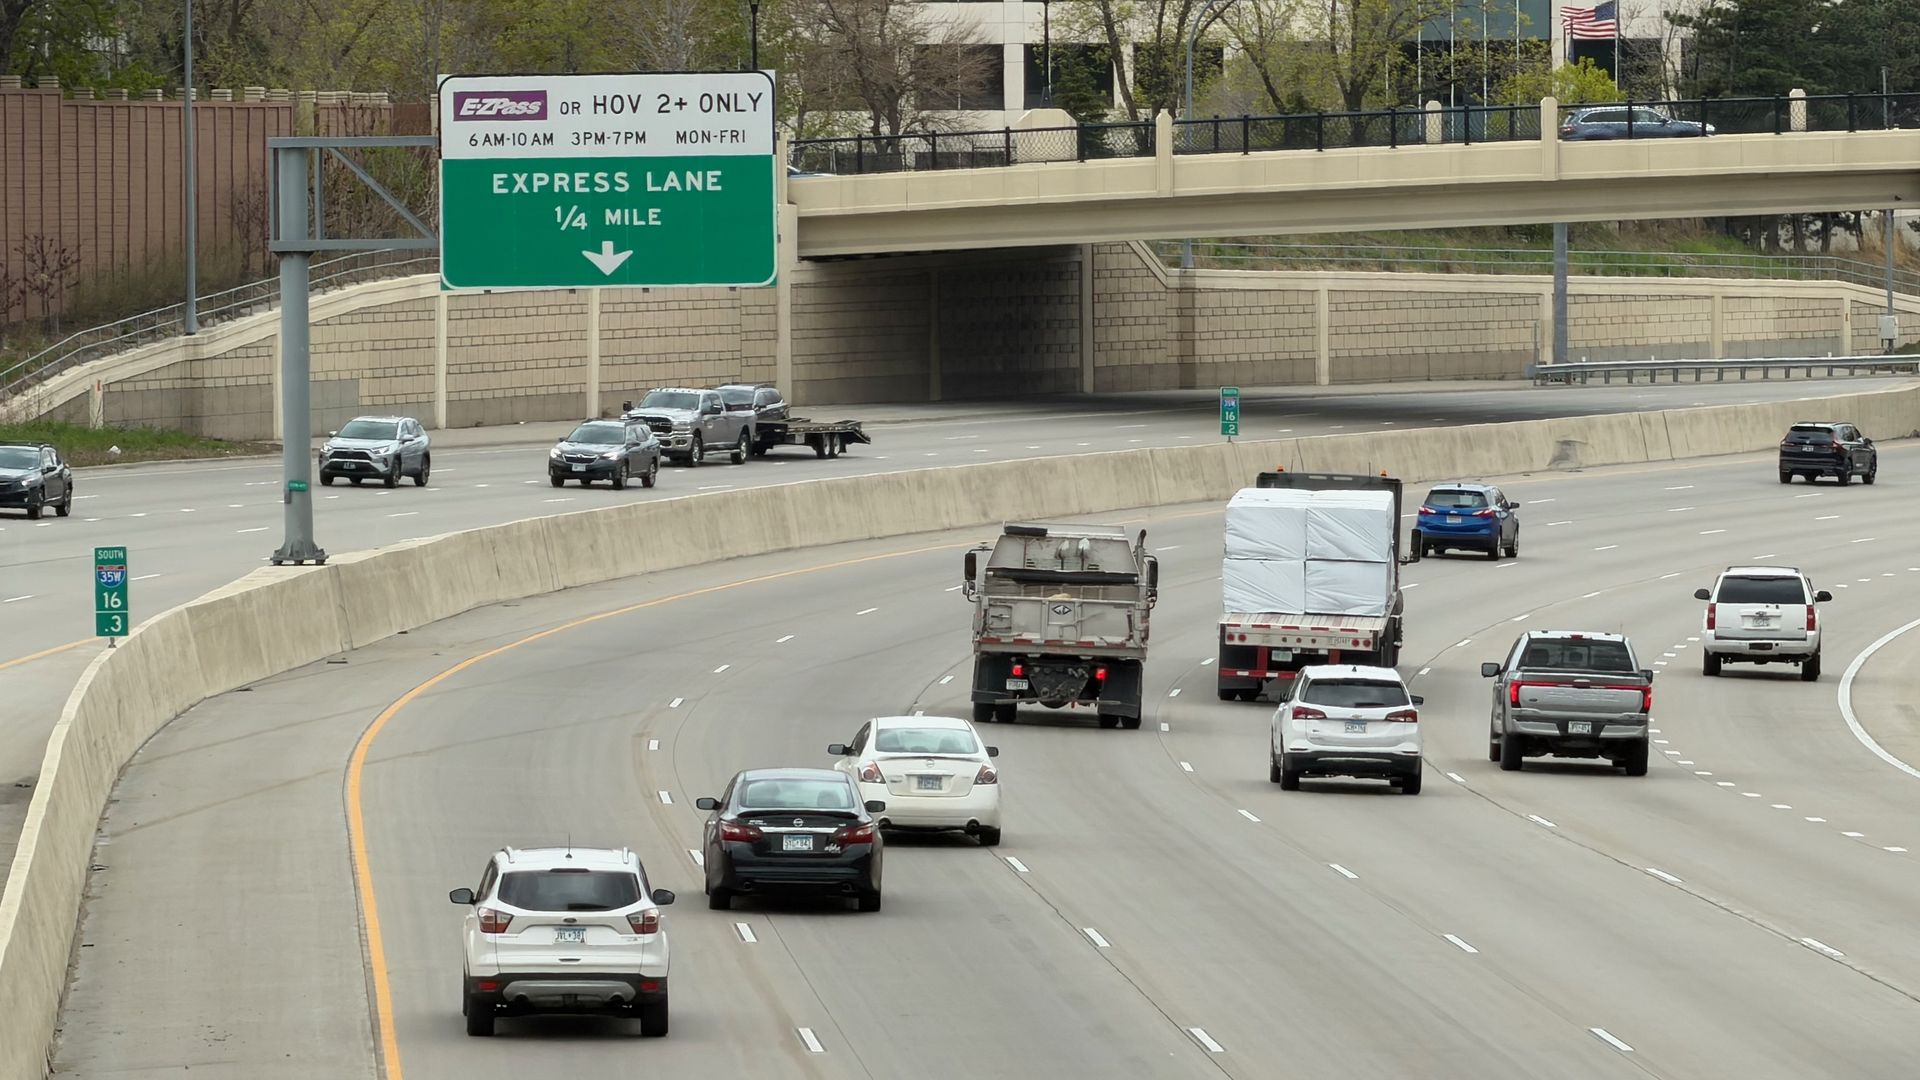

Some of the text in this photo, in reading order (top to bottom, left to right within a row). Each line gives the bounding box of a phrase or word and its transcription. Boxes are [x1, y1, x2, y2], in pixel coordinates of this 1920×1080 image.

[560, 101, 581, 115] OR
[593, 94, 641, 115] HOV
[656, 93, 688, 114] 2+
[699, 92, 763, 113] ONLY
[676, 129, 746, 144] MON-FRI
[493, 170, 722, 194] EXPRESS LANE
[605, 208, 662, 226] MILE
[1225, 411, 1236, 421] 16
[97, 550, 124, 559] SOUTH
[100, 571, 121, 583] 35W
[103, 592, 122, 608] 16
[104, 615, 122, 632] .3
